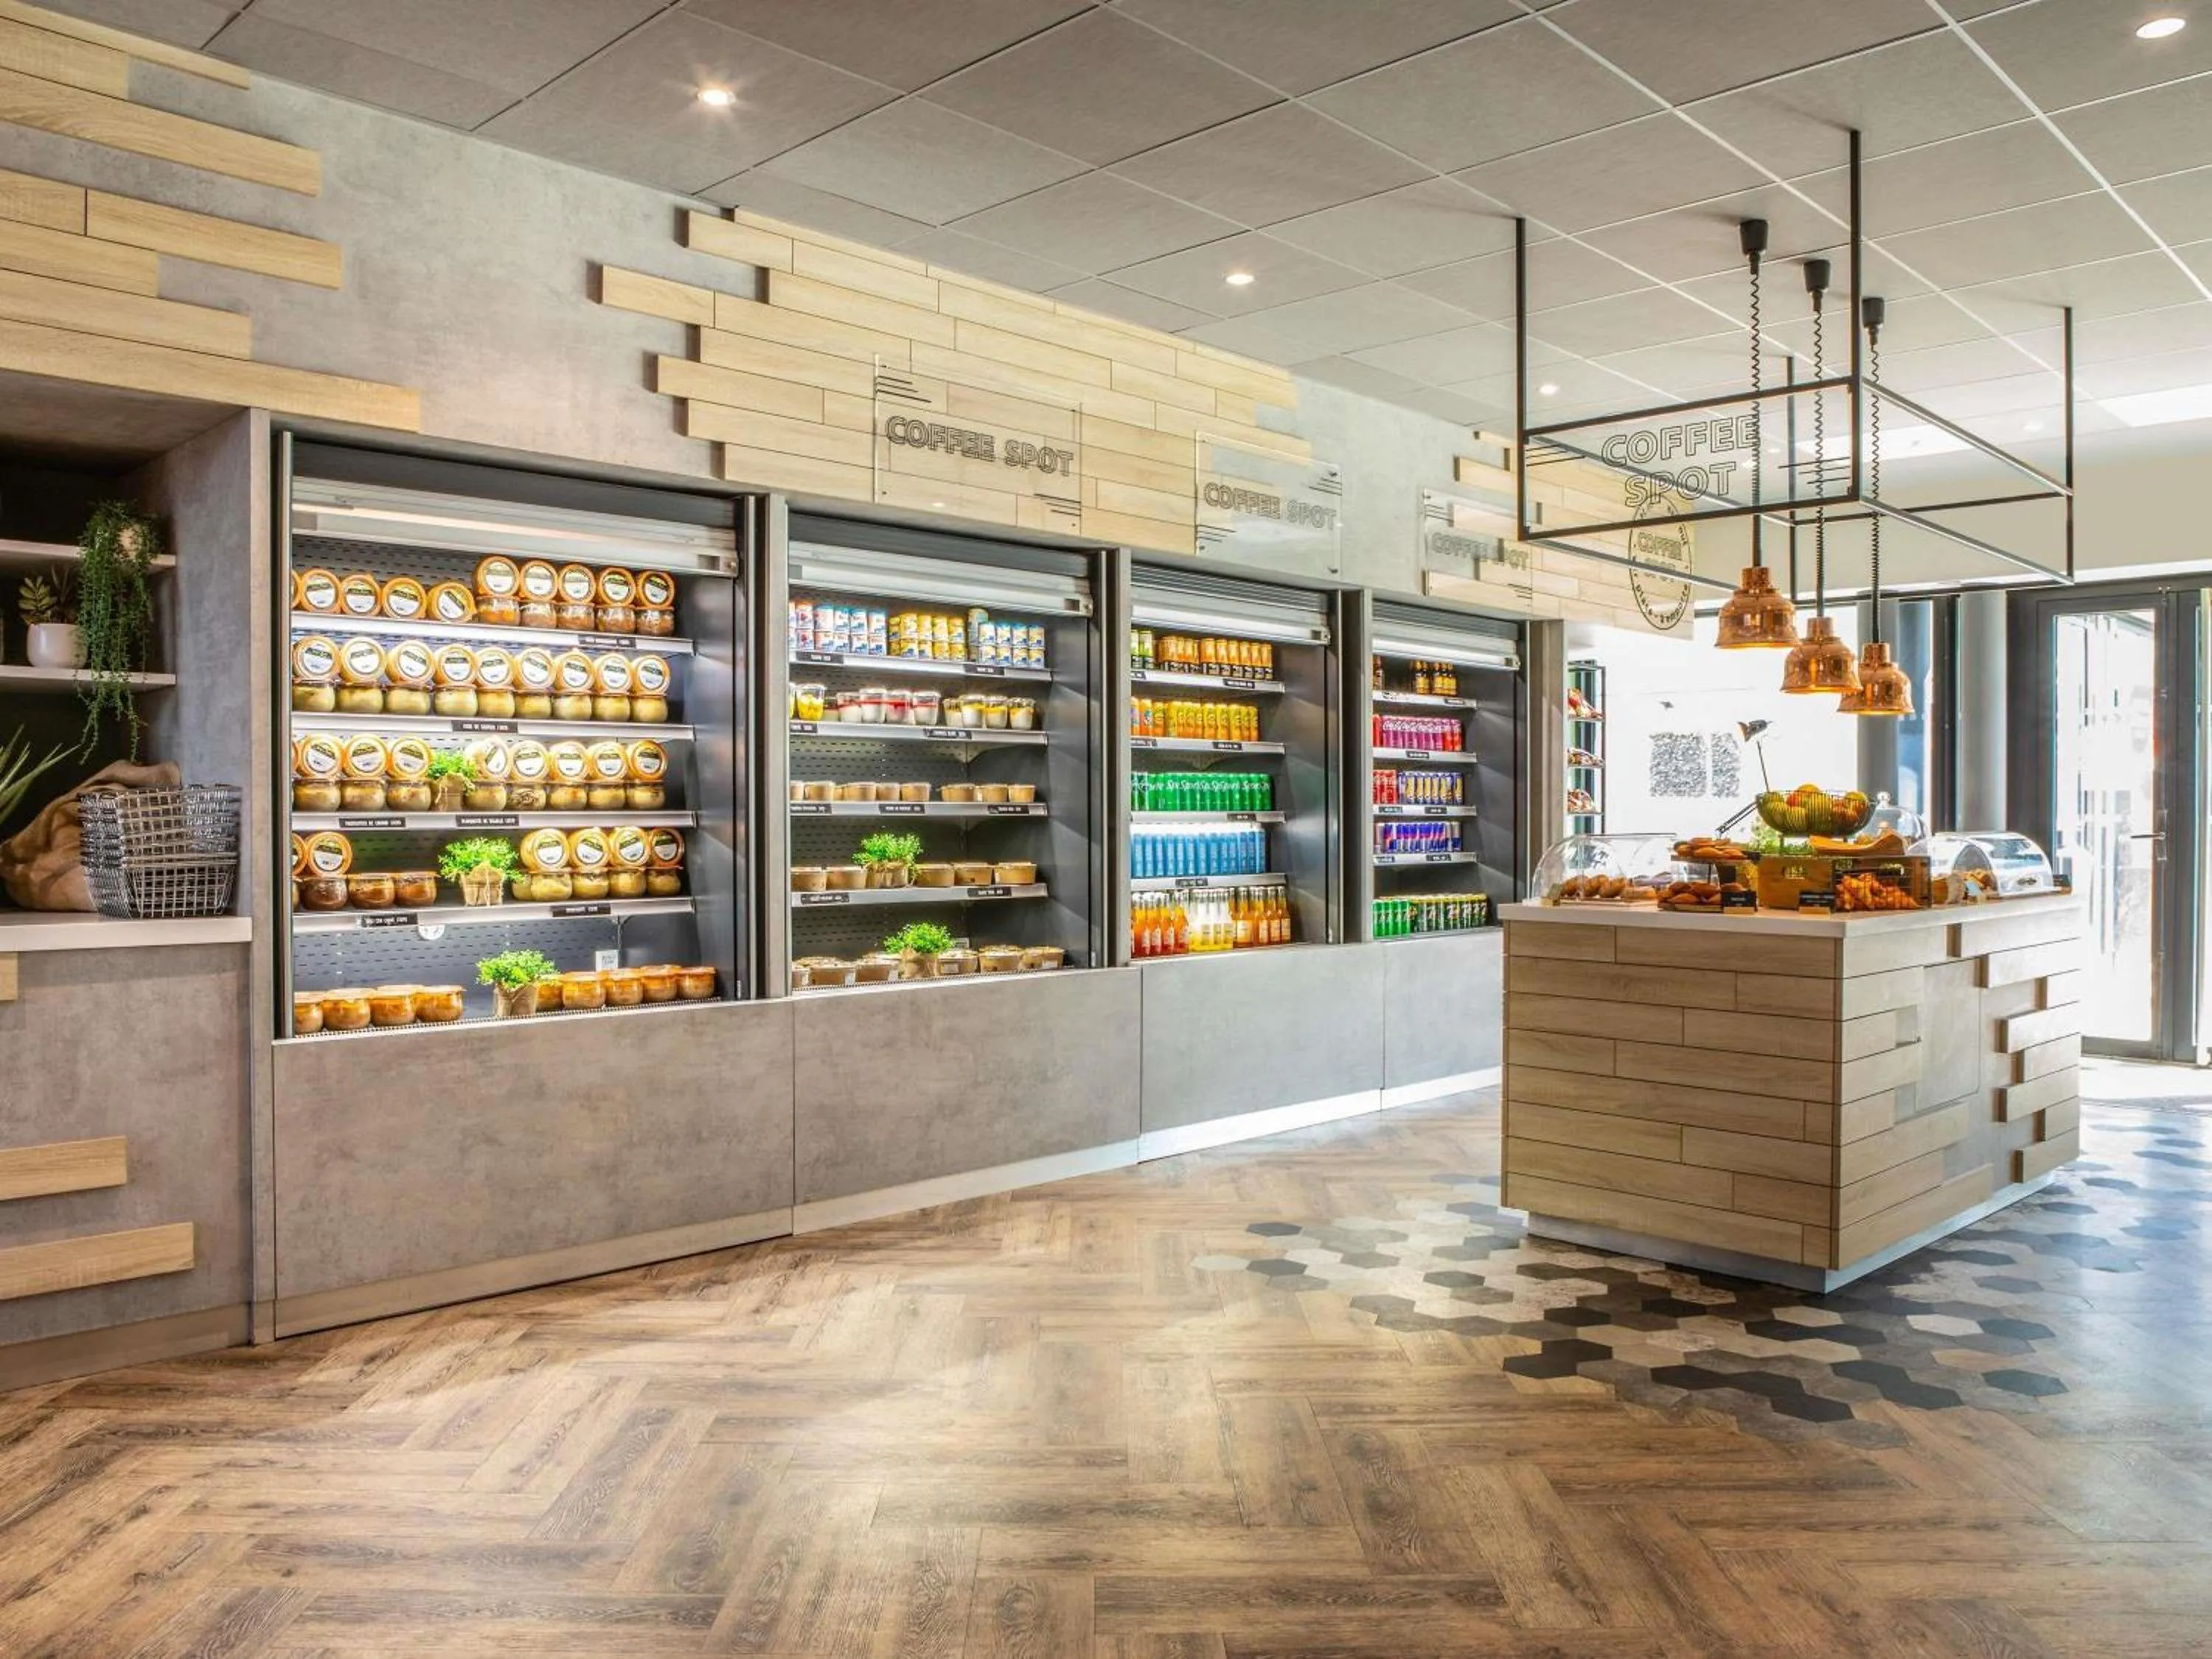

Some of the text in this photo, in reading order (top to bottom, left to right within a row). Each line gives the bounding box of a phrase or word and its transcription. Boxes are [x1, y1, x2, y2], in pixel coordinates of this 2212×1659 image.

[886, 415, 1074, 477] COFFEE SPOT
[1601, 414, 1760, 467] COFFEE
[1203, 481, 1337, 531] COFFEE SPOT
[1624, 461, 1737, 508] SPOT
[1431, 532, 1488, 563] COFFEE
